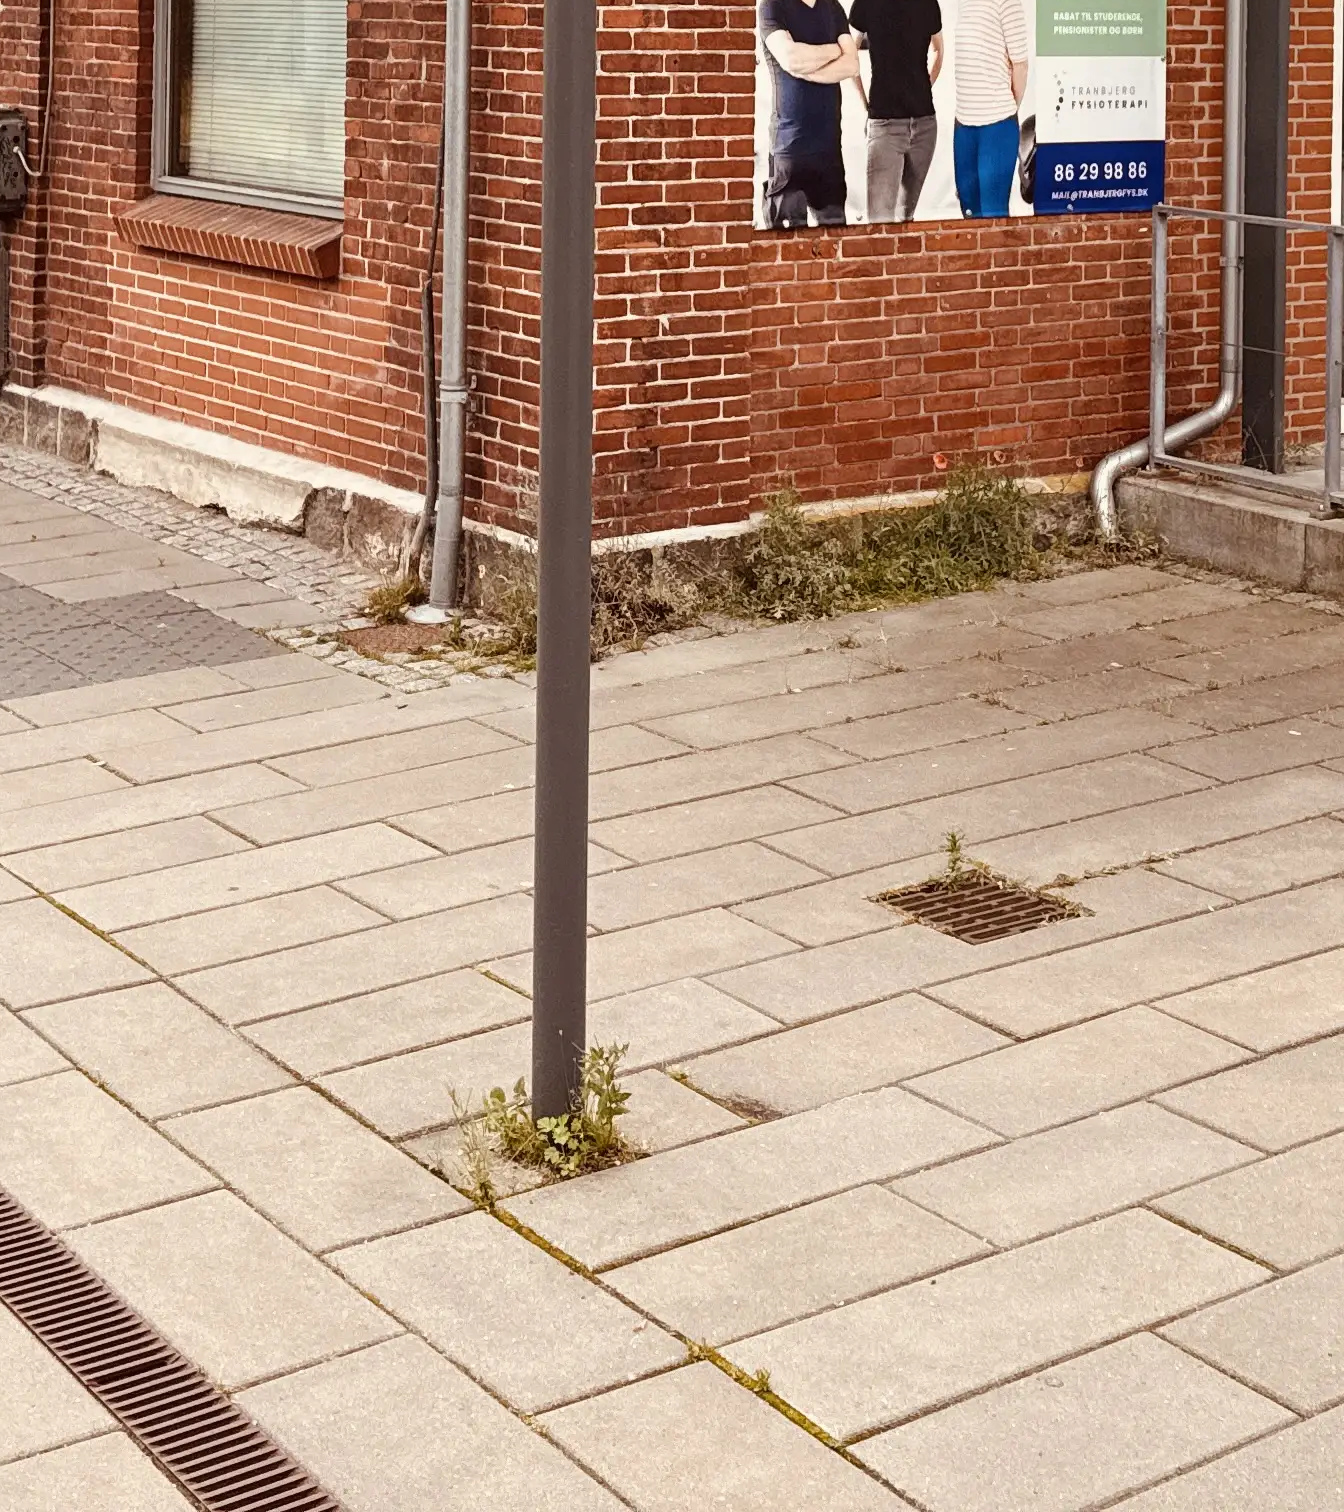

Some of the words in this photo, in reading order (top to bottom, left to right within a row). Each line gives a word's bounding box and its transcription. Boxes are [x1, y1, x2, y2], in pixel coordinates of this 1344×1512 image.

[1054, 11, 1080, 21] RABAT
[1081, 12, 1092, 21] TIL
[1109, 26, 1121, 35] OG
[1071, 85, 1136, 96] TRANBJERG
[1071, 99, 1148, 110] FYSIOTERAPI
[1054, 163, 1075, 182] 86
[1079, 162, 1099, 181] 29
[1103, 161, 1123, 180] 98
[1128, 161, 1147, 179] 86
